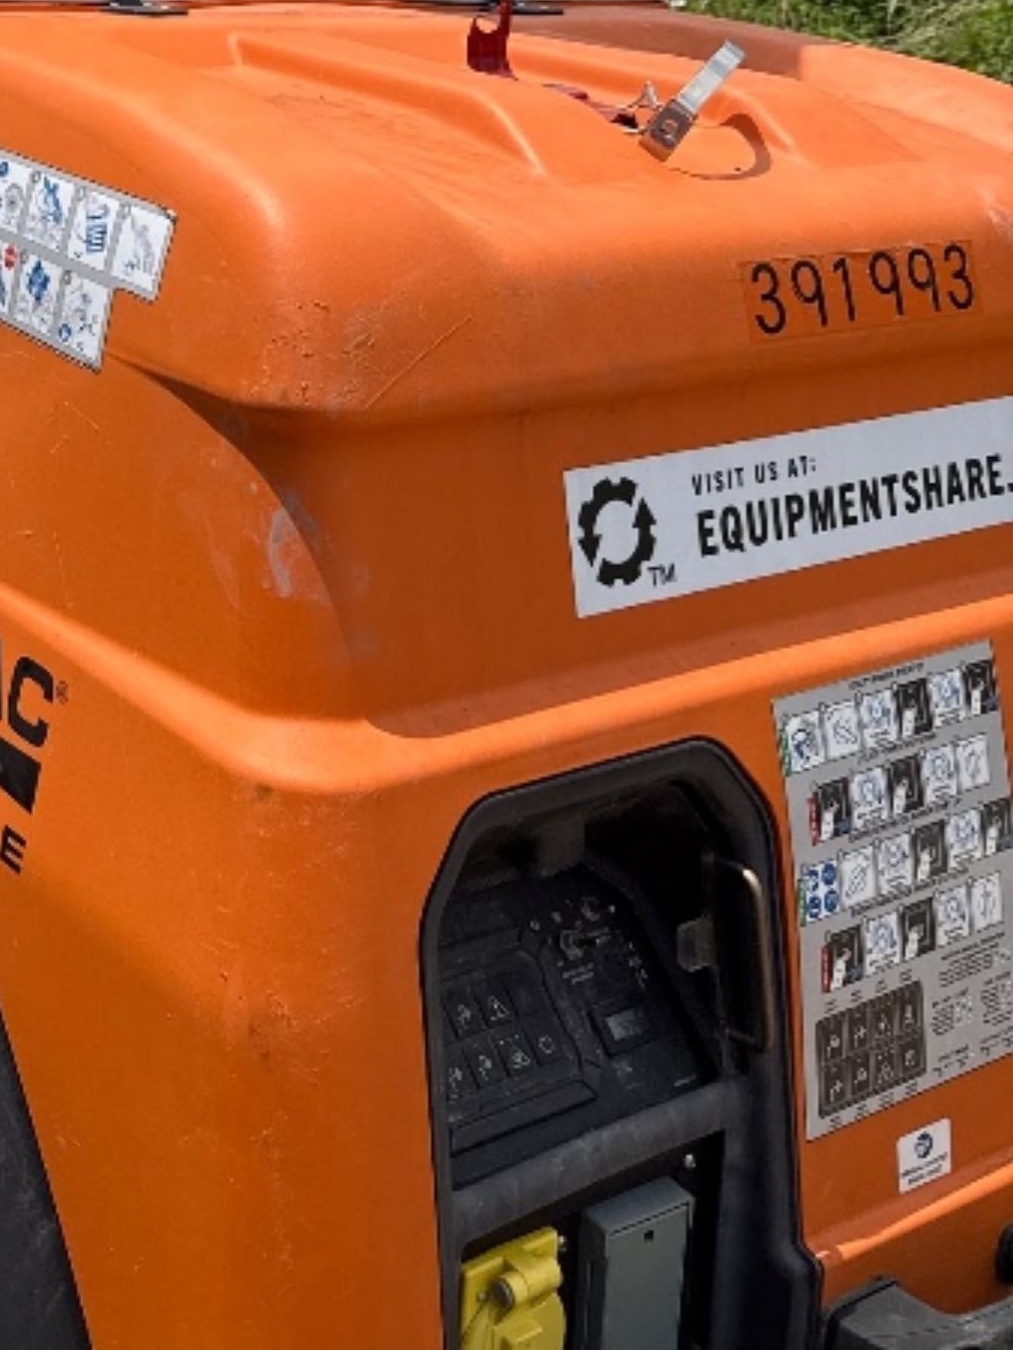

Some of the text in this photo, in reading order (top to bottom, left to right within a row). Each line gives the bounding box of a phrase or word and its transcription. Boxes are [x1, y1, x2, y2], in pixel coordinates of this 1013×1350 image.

[751, 243, 974, 335] 391993
[692, 456, 817, 496] VISIT US AT:
[648, 564, 677, 588] TM
